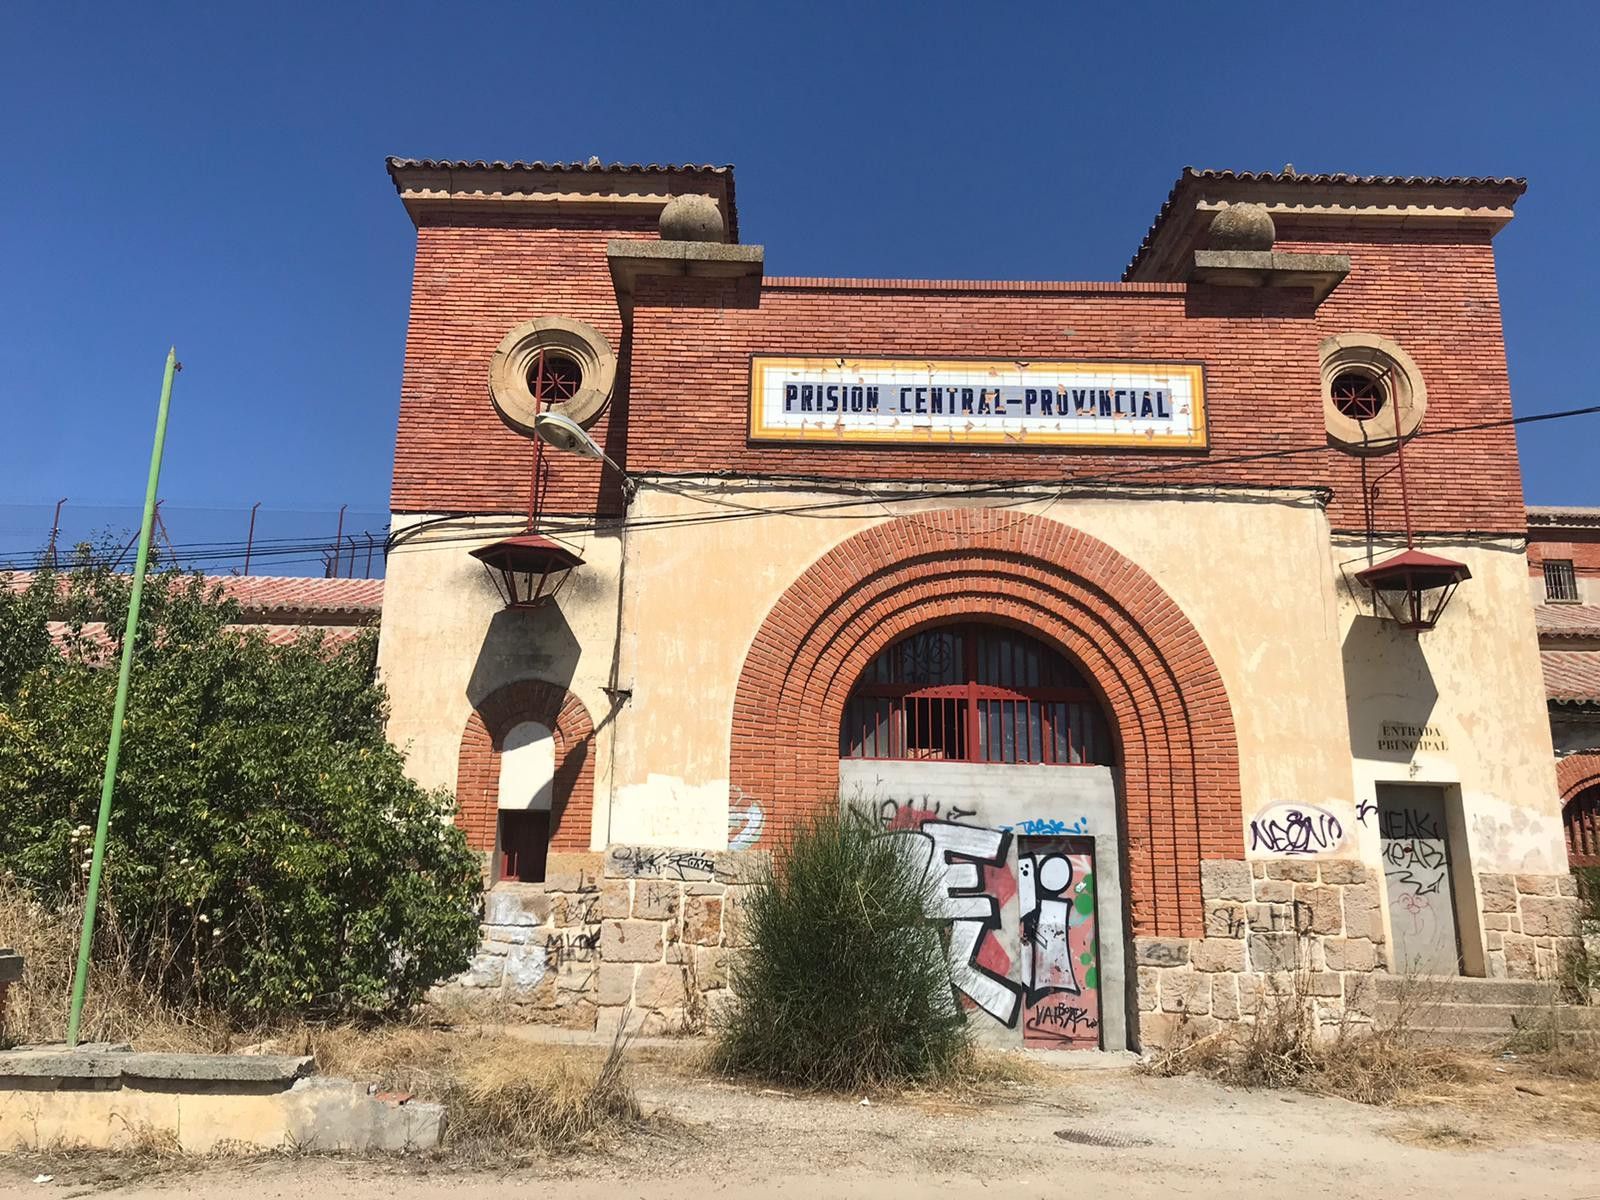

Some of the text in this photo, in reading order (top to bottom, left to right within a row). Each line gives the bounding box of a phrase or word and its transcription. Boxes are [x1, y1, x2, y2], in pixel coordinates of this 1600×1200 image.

[785, 384, 880, 413] PRISION
[1382, 725, 1441, 737] ENTRADA
[1377, 739, 1449, 751] PRINCIPAL
